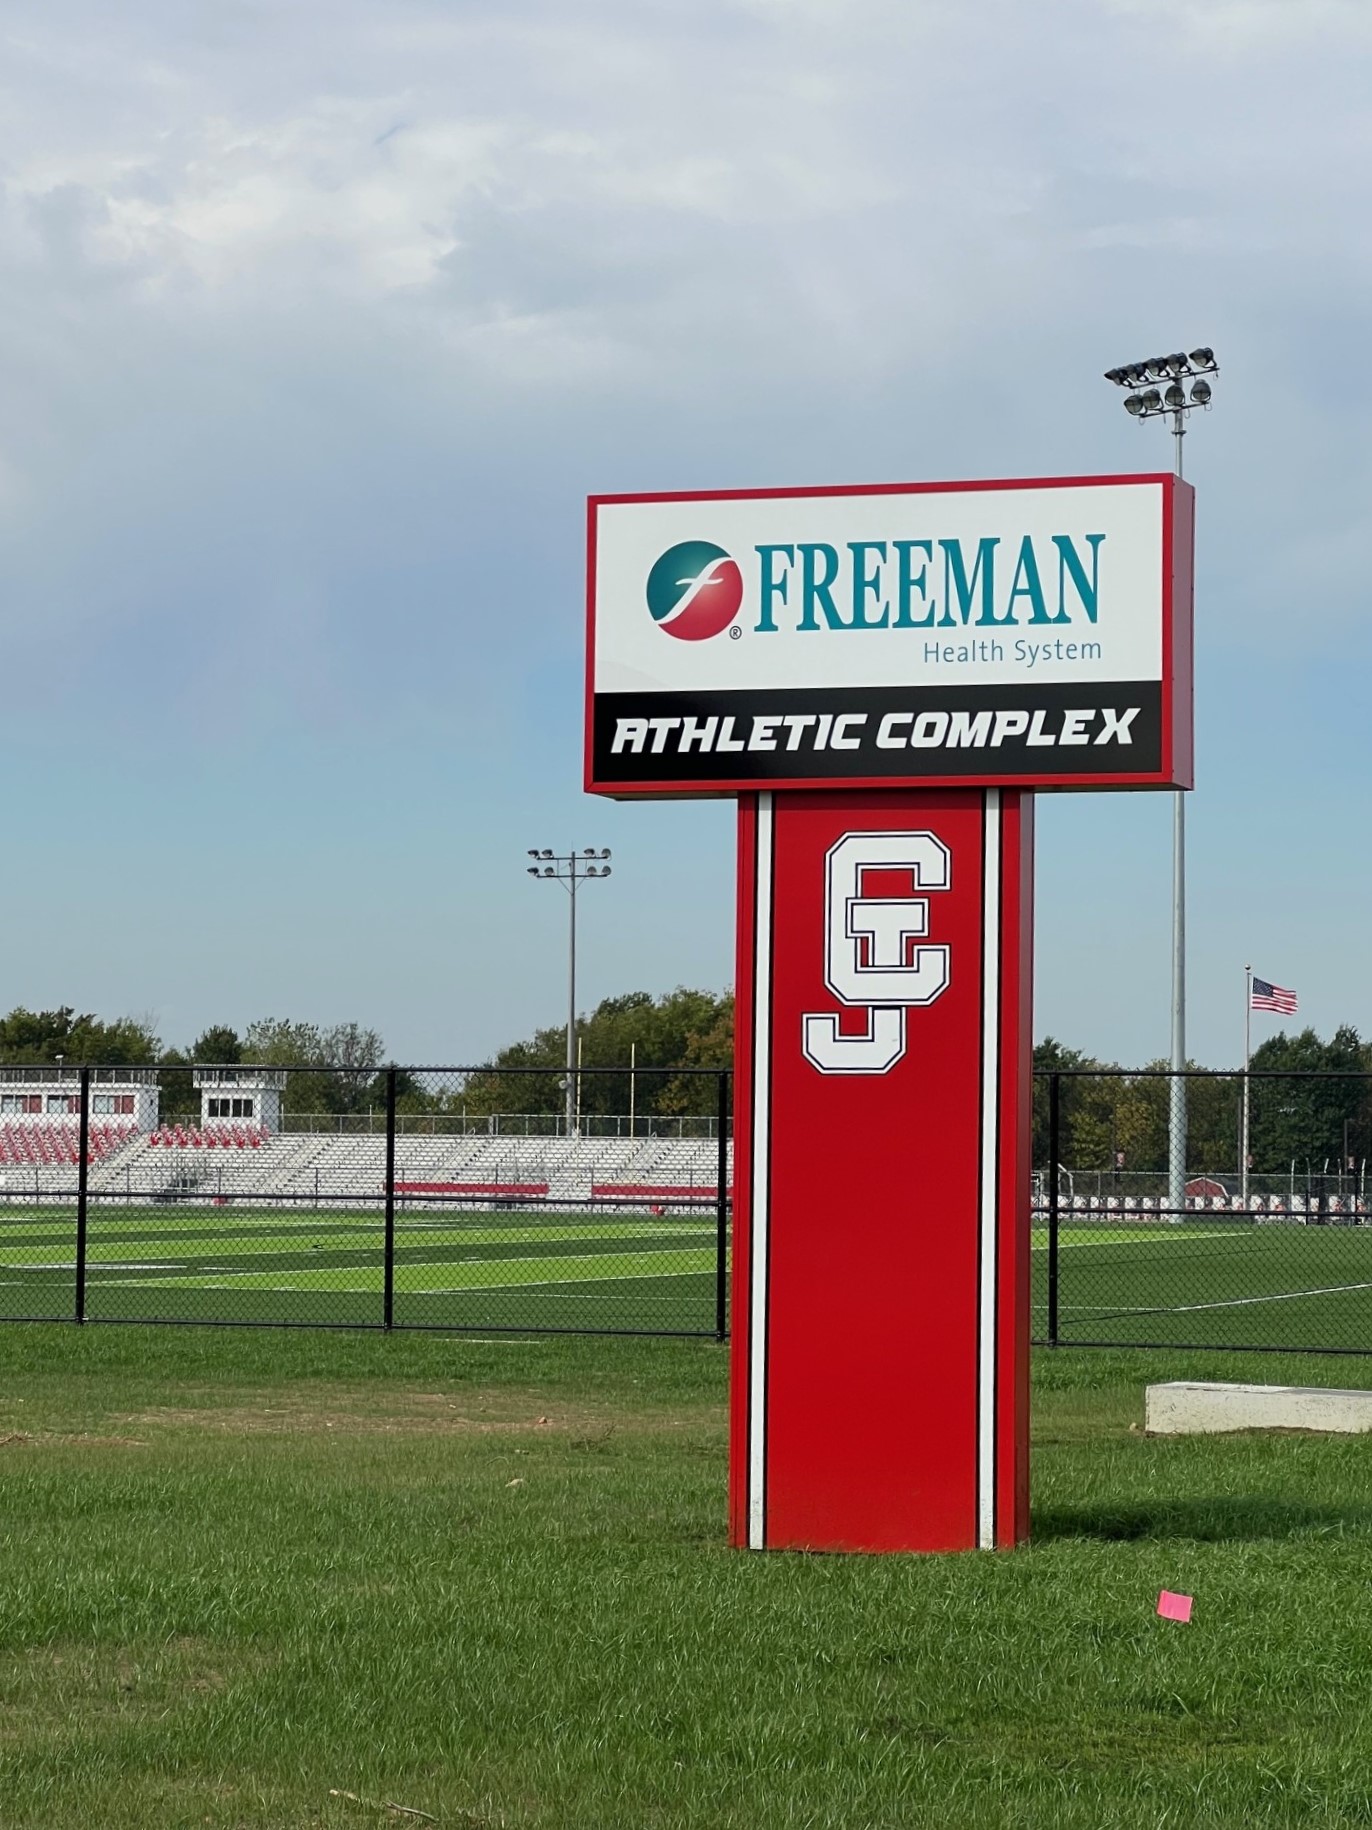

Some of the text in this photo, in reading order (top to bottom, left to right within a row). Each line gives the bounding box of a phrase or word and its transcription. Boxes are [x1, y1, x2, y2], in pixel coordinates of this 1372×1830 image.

[754, 533, 1107, 633] FREEMAN
[923, 638, 1102, 669] Health System
[610, 707, 1141, 754] ATHLETIC COMPLEX
